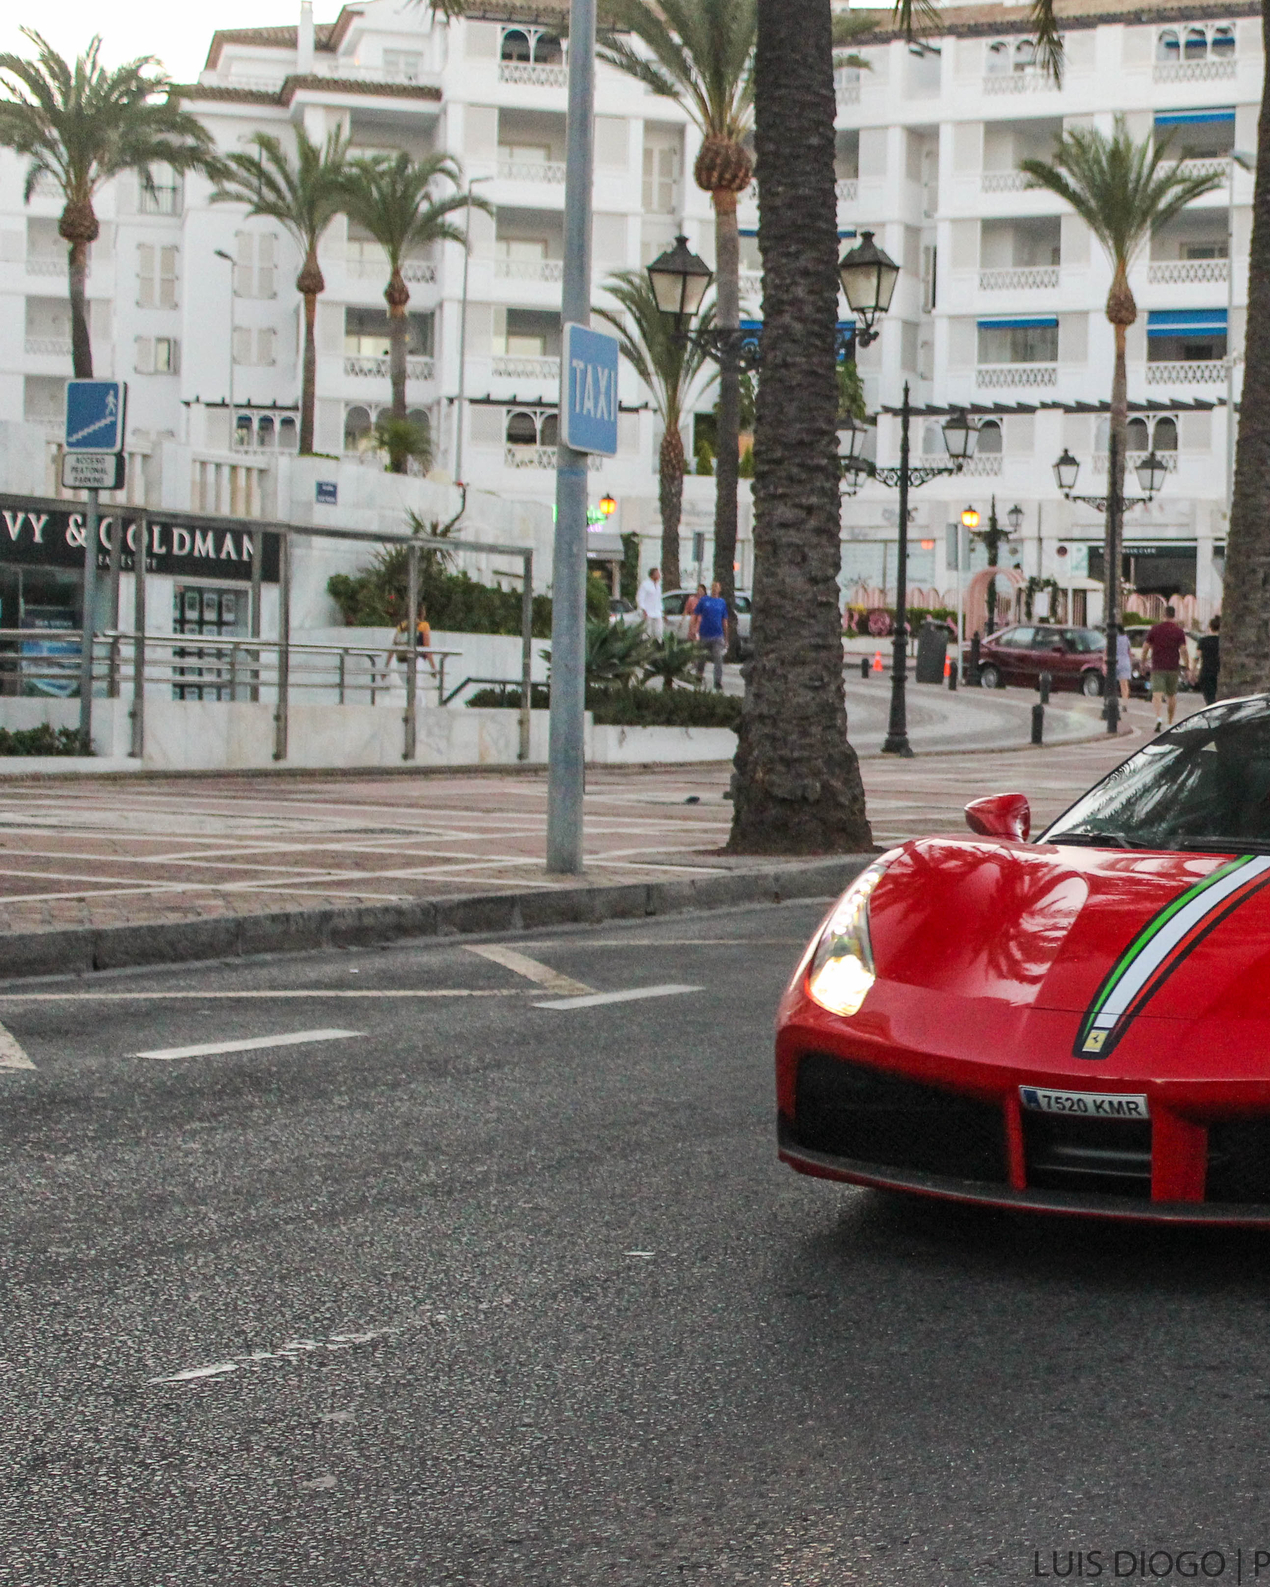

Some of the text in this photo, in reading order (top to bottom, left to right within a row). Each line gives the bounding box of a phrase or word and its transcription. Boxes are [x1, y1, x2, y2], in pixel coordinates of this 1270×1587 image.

[572, 359, 616, 421] TAXI
[65, 513, 87, 548] &
[1042, 1094, 1143, 1116] 7520 KMR
